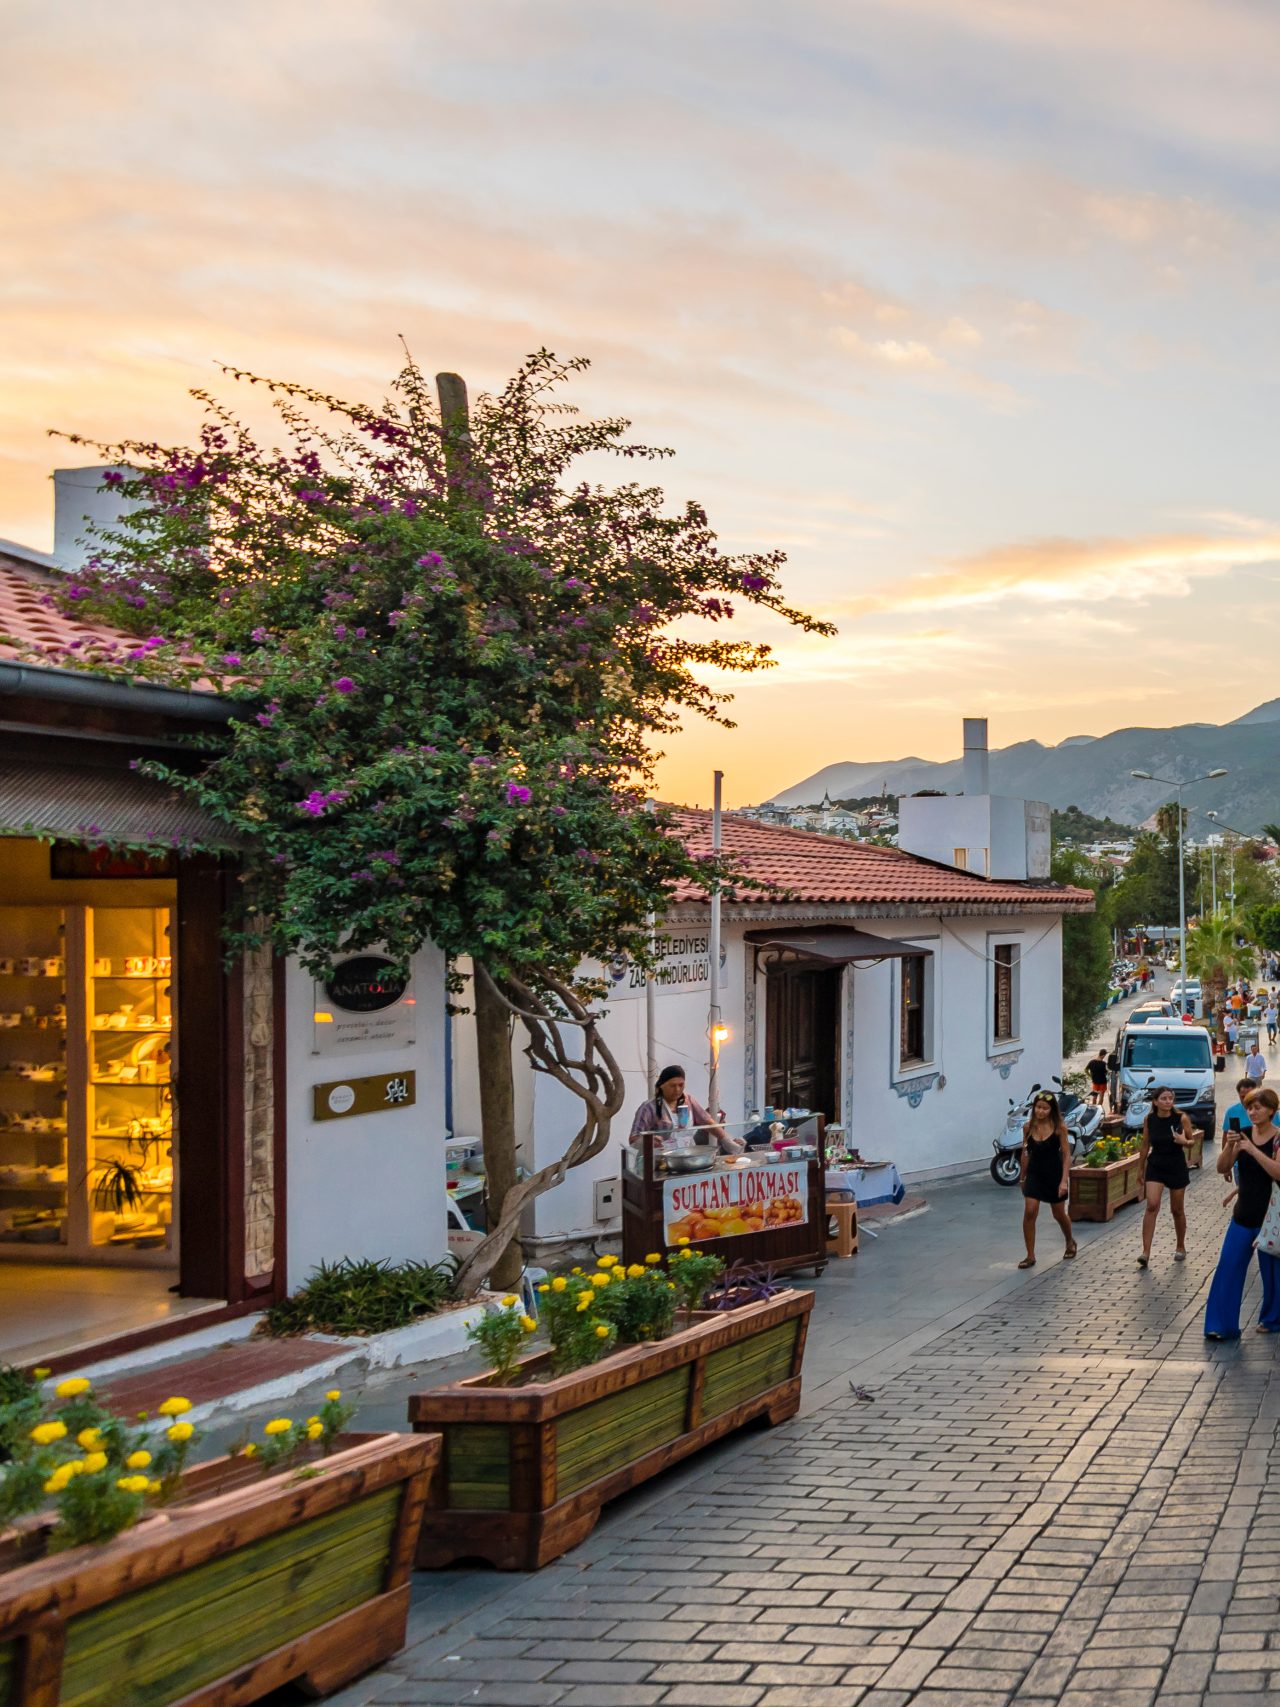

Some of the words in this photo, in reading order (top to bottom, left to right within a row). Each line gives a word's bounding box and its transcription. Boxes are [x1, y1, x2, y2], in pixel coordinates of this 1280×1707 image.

[654, 933, 709, 957] BELEDİYESİ
[672, 1174, 730, 1210] SULTAN
[737, 1171, 799, 1207] LOKMASI
